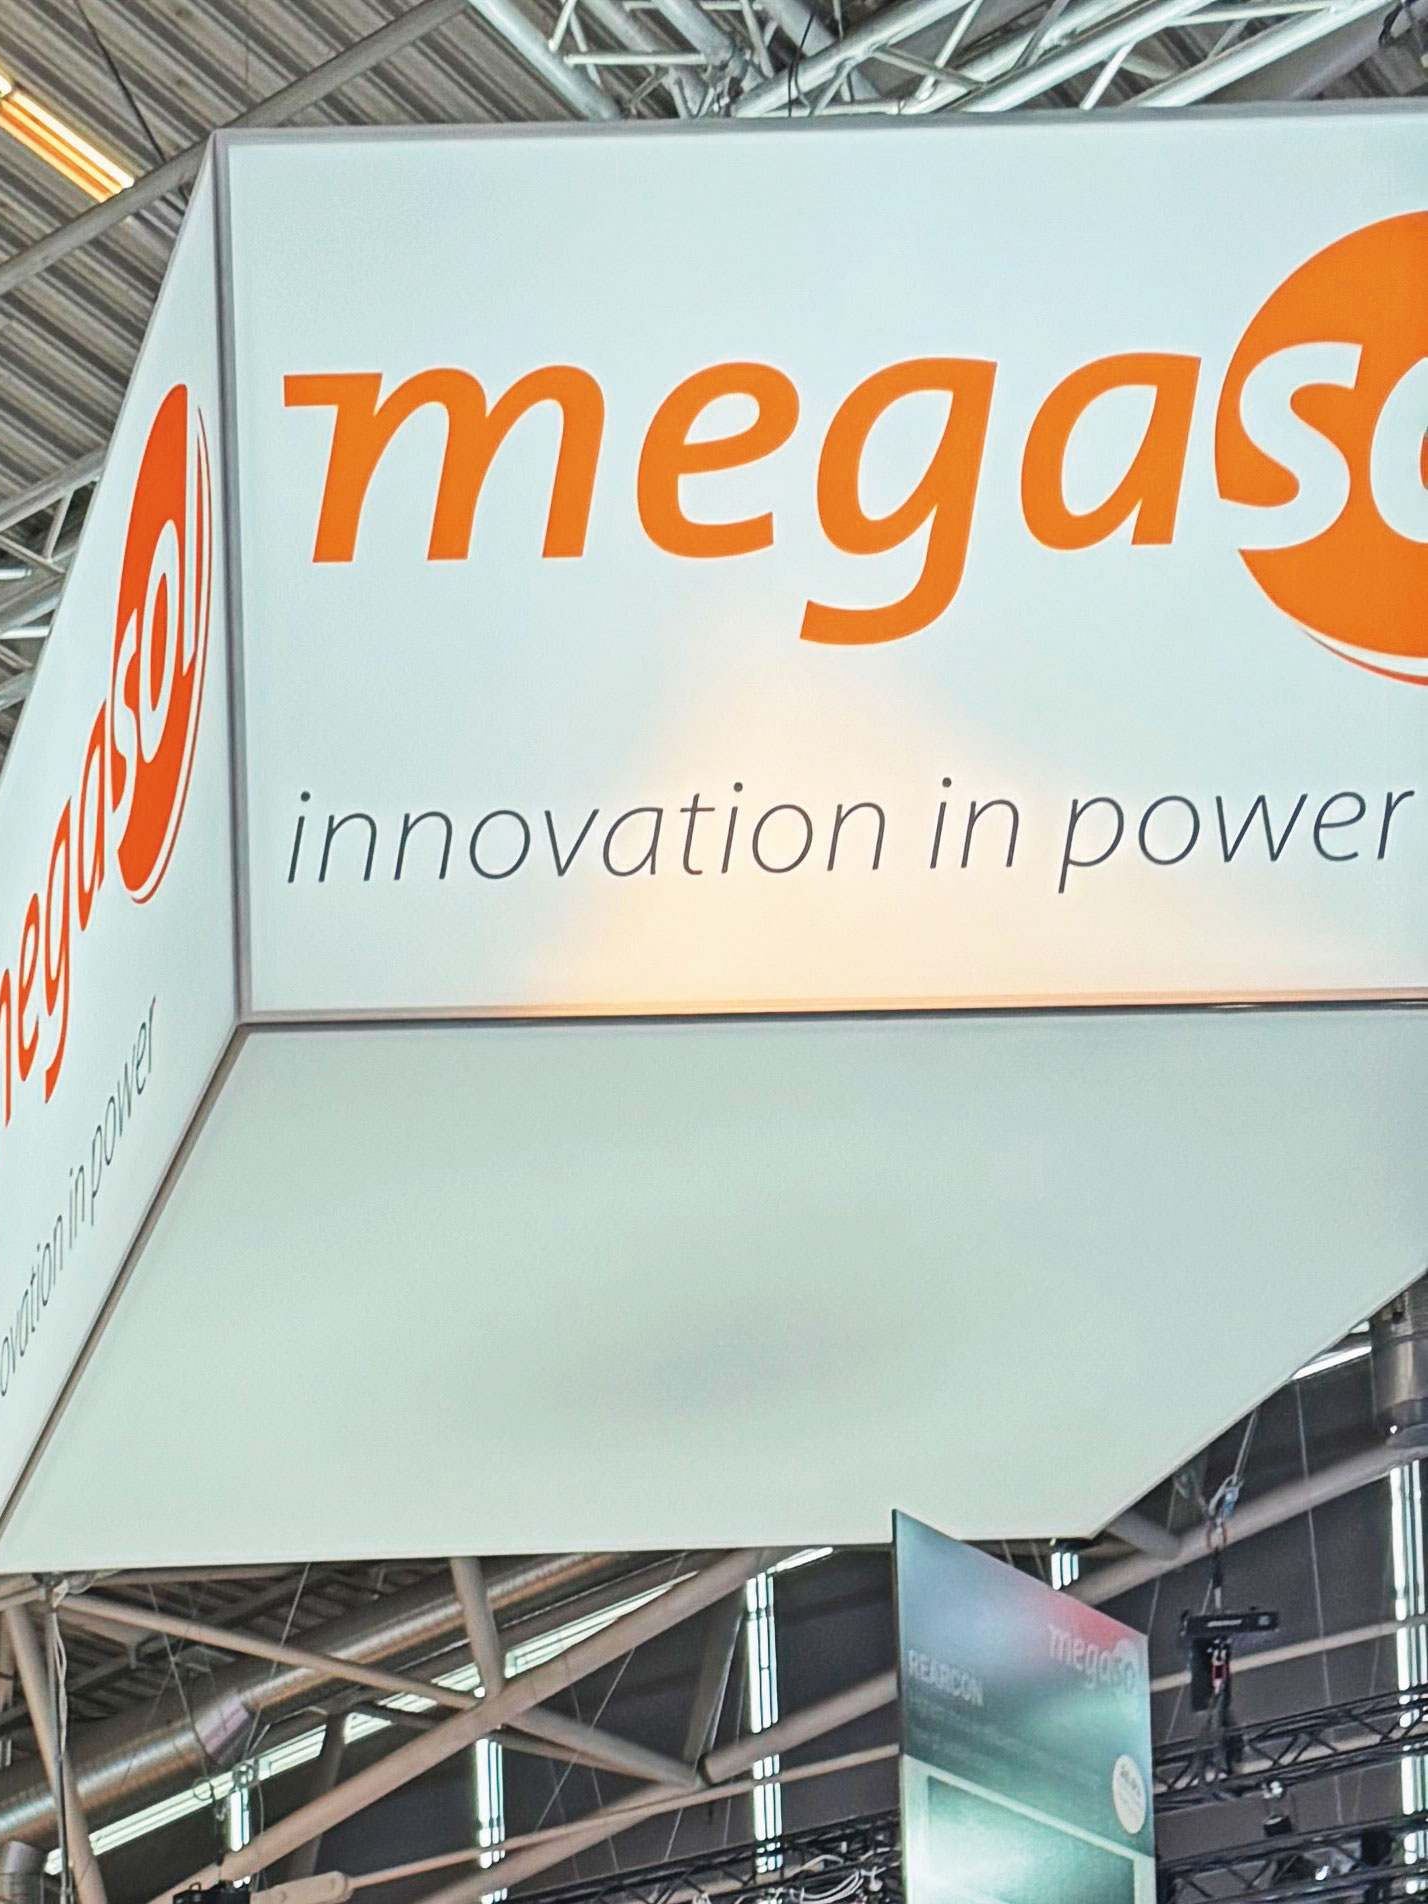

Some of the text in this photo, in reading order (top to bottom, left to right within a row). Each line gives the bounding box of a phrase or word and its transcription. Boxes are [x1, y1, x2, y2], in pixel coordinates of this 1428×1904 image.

[287, 775, 1416, 895] innovation in power
[69, 1163, 85, 1251] in
[90, 995, 156, 1228] power
